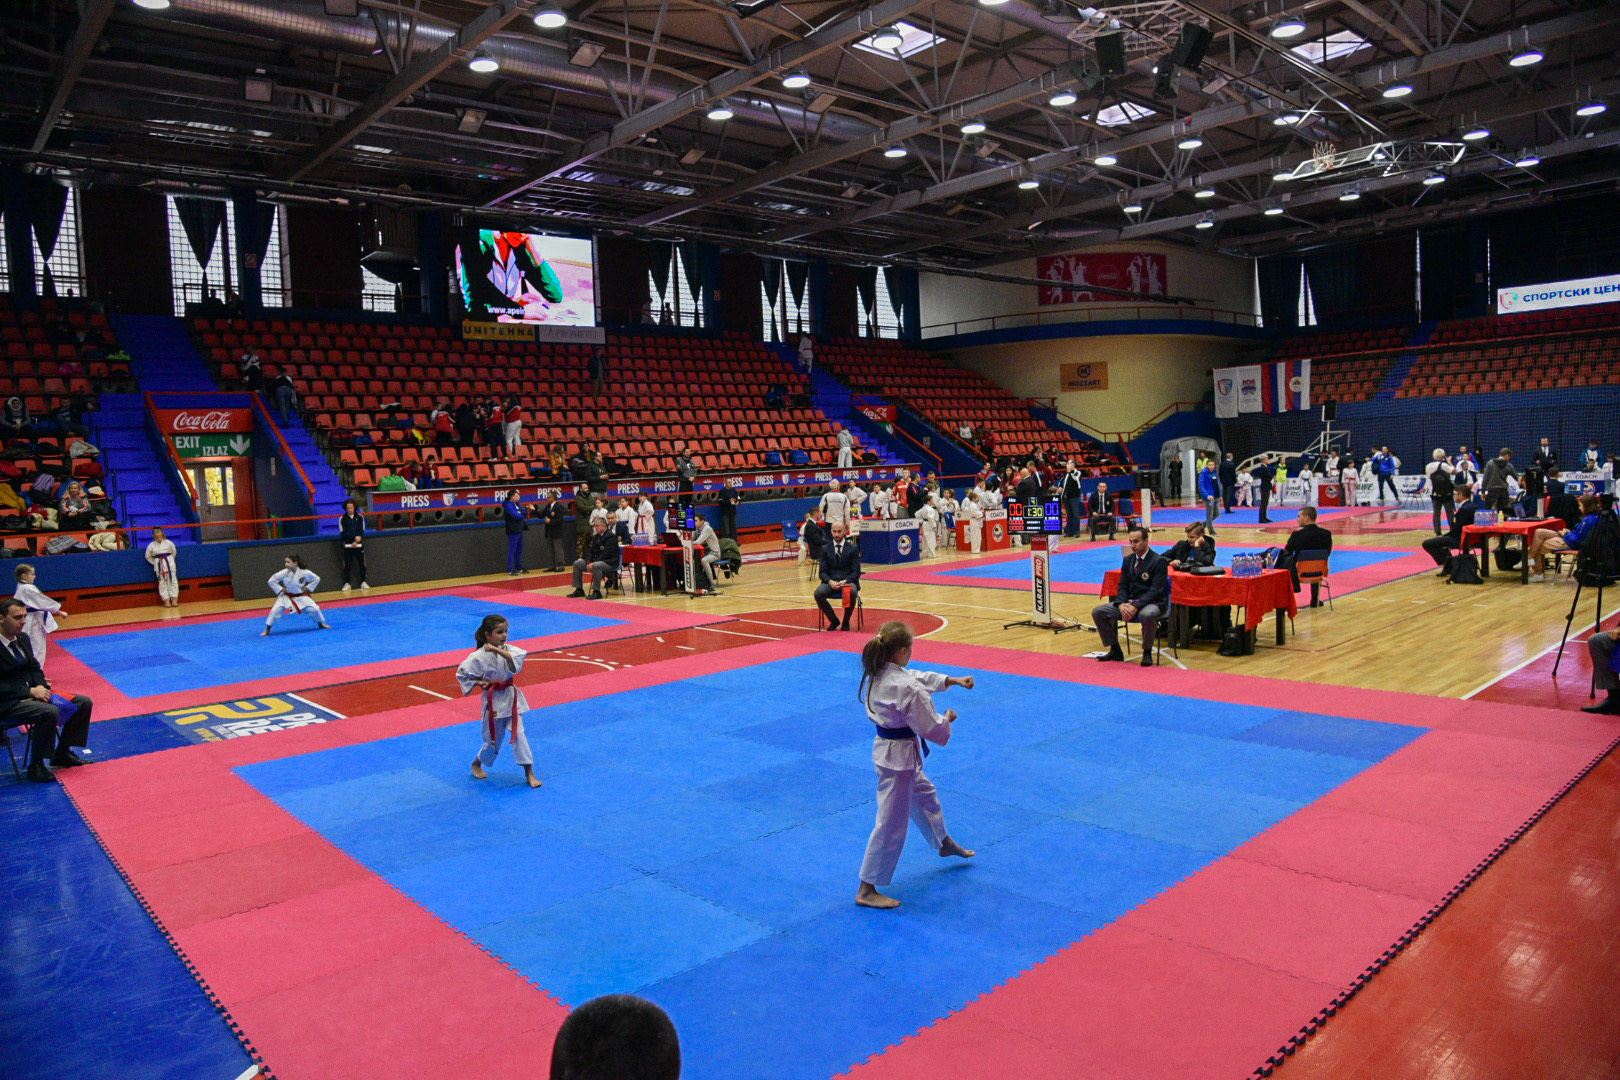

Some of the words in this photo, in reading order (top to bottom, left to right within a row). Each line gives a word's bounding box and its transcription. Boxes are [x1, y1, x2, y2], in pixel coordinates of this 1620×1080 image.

[1522, 287, 1590, 302] СПОРТСКИ
[464, 326, 534, 337] UNITEHNA
[1068, 379, 1101, 387] MOZZART
[173, 411, 232, 430] Coca-Cola
[175, 435, 201, 449] EXIT
[202, 445, 229, 456] IZLAZ
[755, 475, 774, 486] PRESS
[814, 471, 832, 481] PRESS
[842, 470, 860, 480] PRESS
[617, 483, 640, 495] PRESS
[654, 481, 676, 492] PRESS
[401, 494, 430, 508] PRESS
[1009, 503, 1023, 516] 00
[1045, 502, 1059, 516] 00
[895, 520, 913, 528] COACH
[1034, 557, 1043, 577] PRO
[1035, 577, 1045, 613] KARATE
